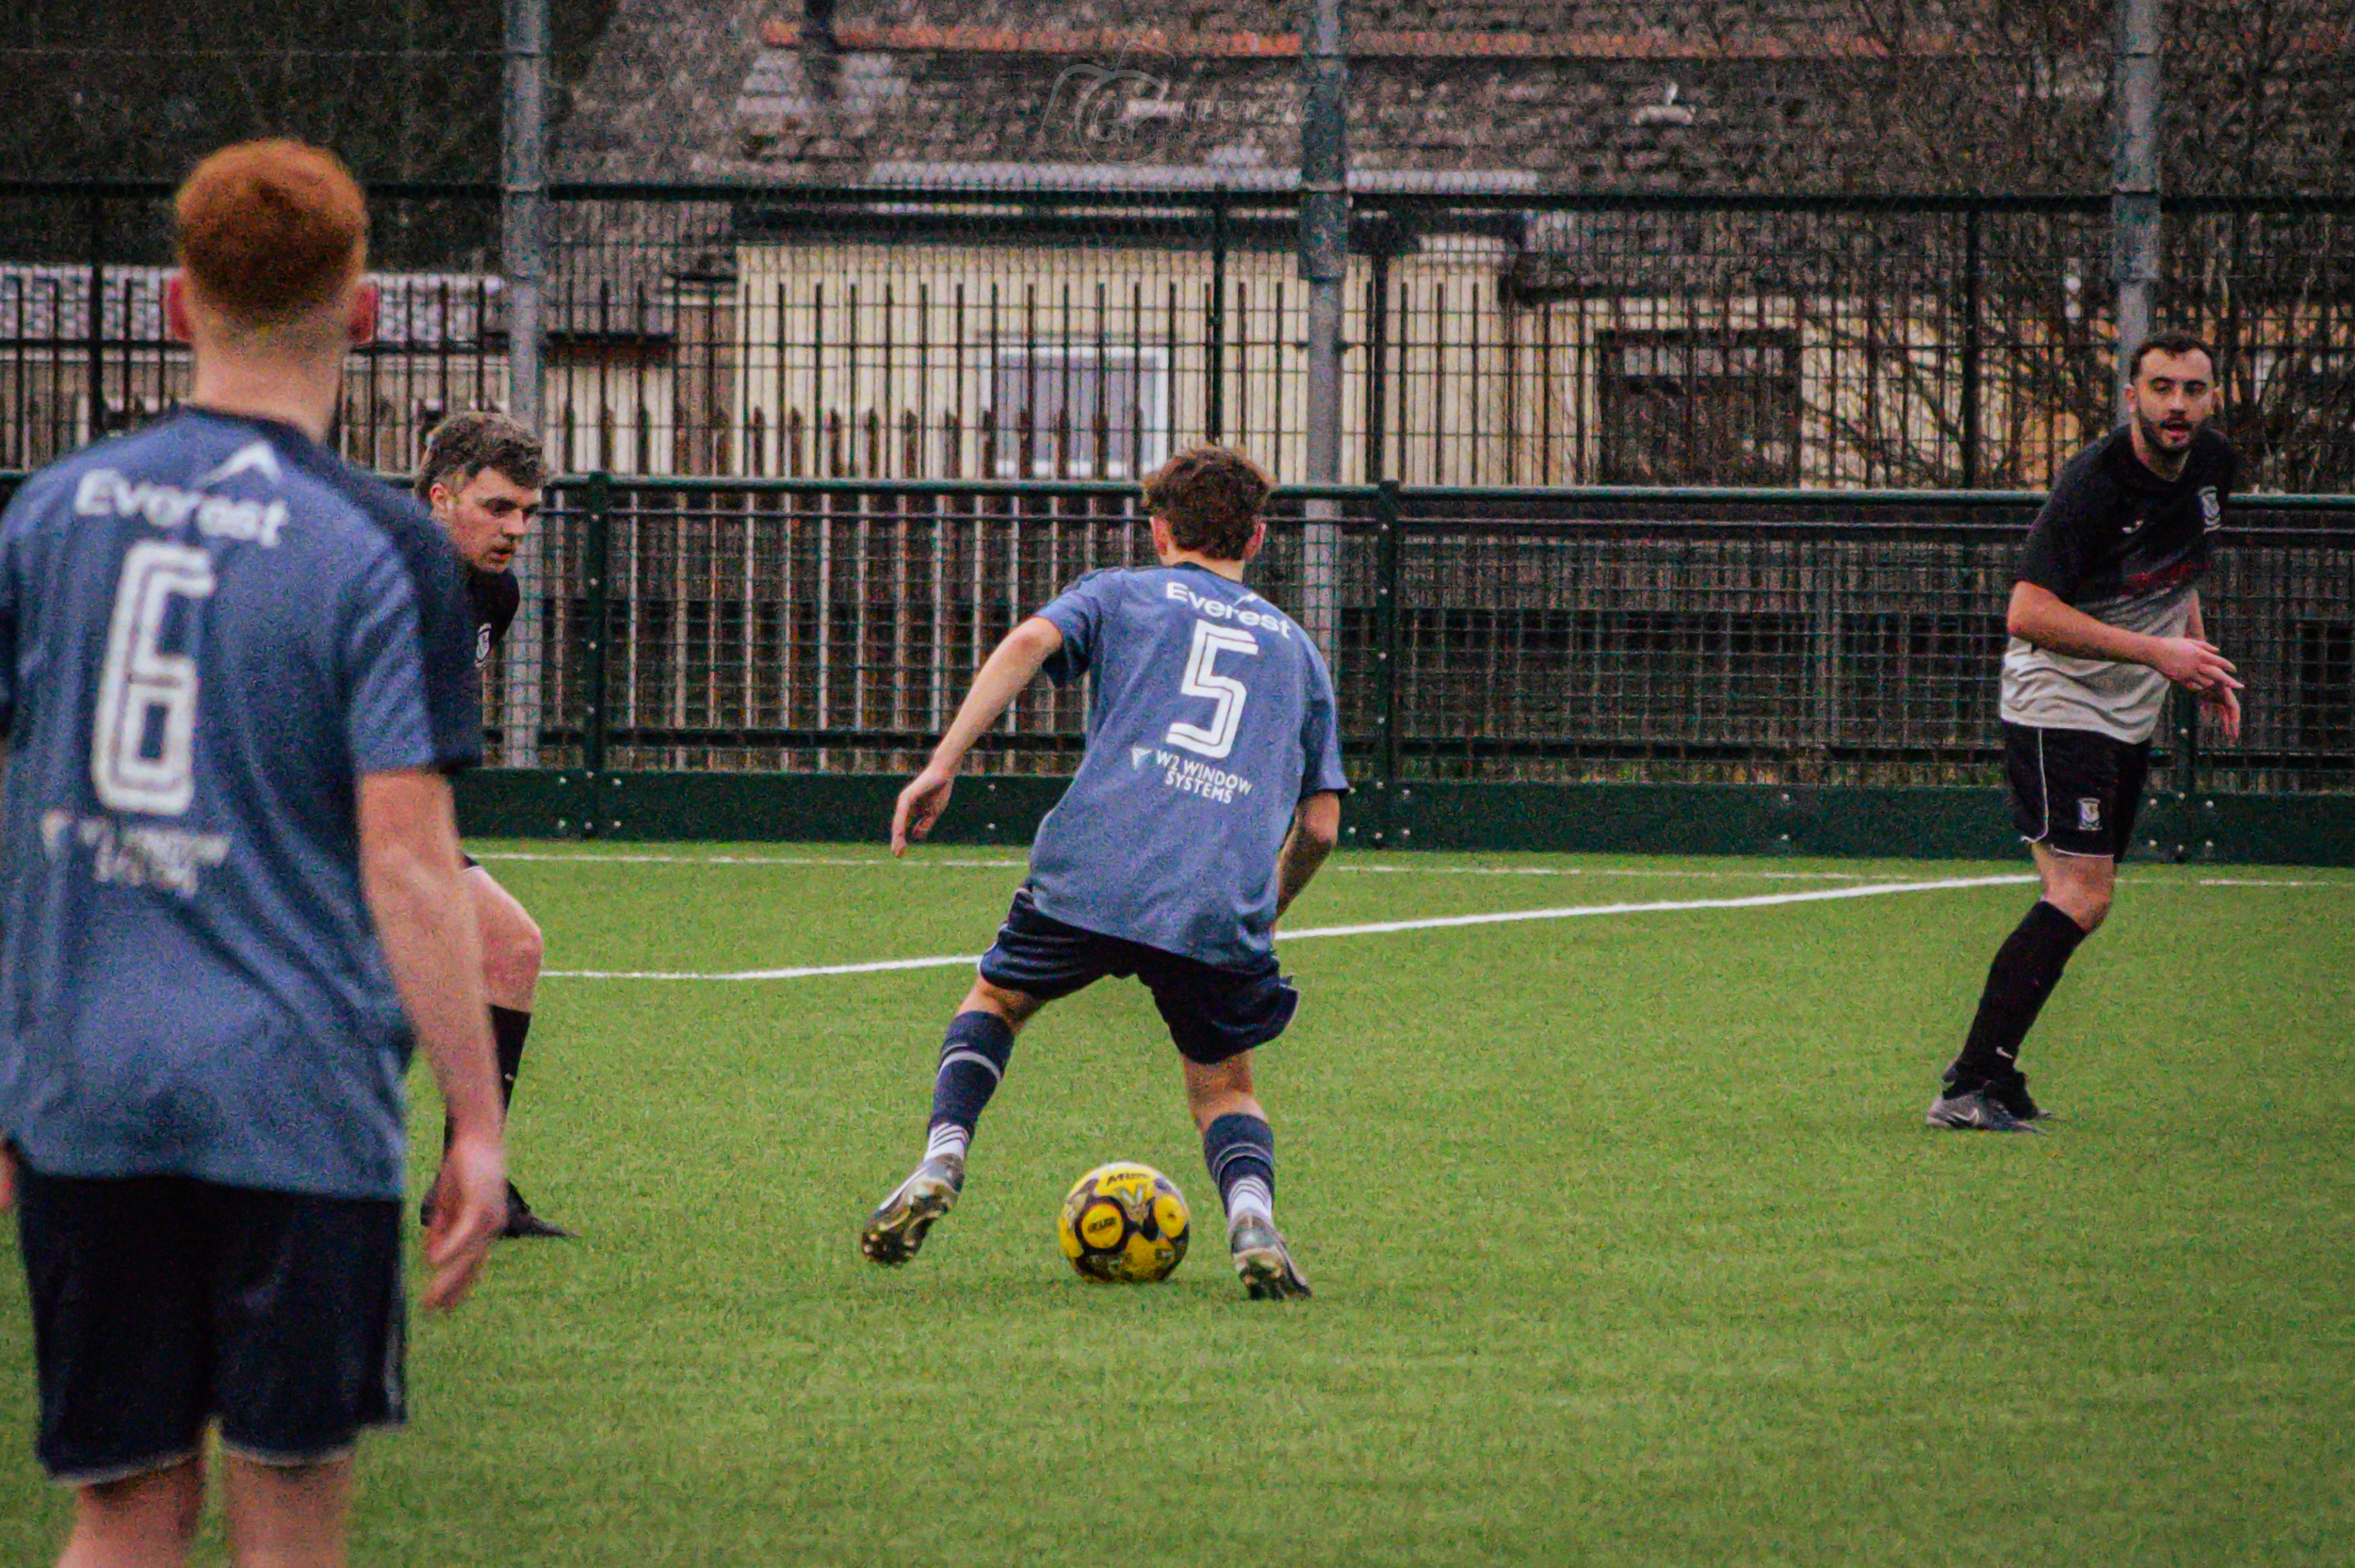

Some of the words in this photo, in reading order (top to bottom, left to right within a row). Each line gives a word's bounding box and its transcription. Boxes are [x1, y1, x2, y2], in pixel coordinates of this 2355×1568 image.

[74, 469, 288, 547] Everest
[1166, 581, 1291, 639] Everest
[92, 539, 217, 816] 6
[1166, 619, 1259, 759] 5
[1156, 750, 1180, 771] W2
[1183, 759, 1253, 796] WINDOW
[1164, 770, 1233, 805] SYSTEMS
